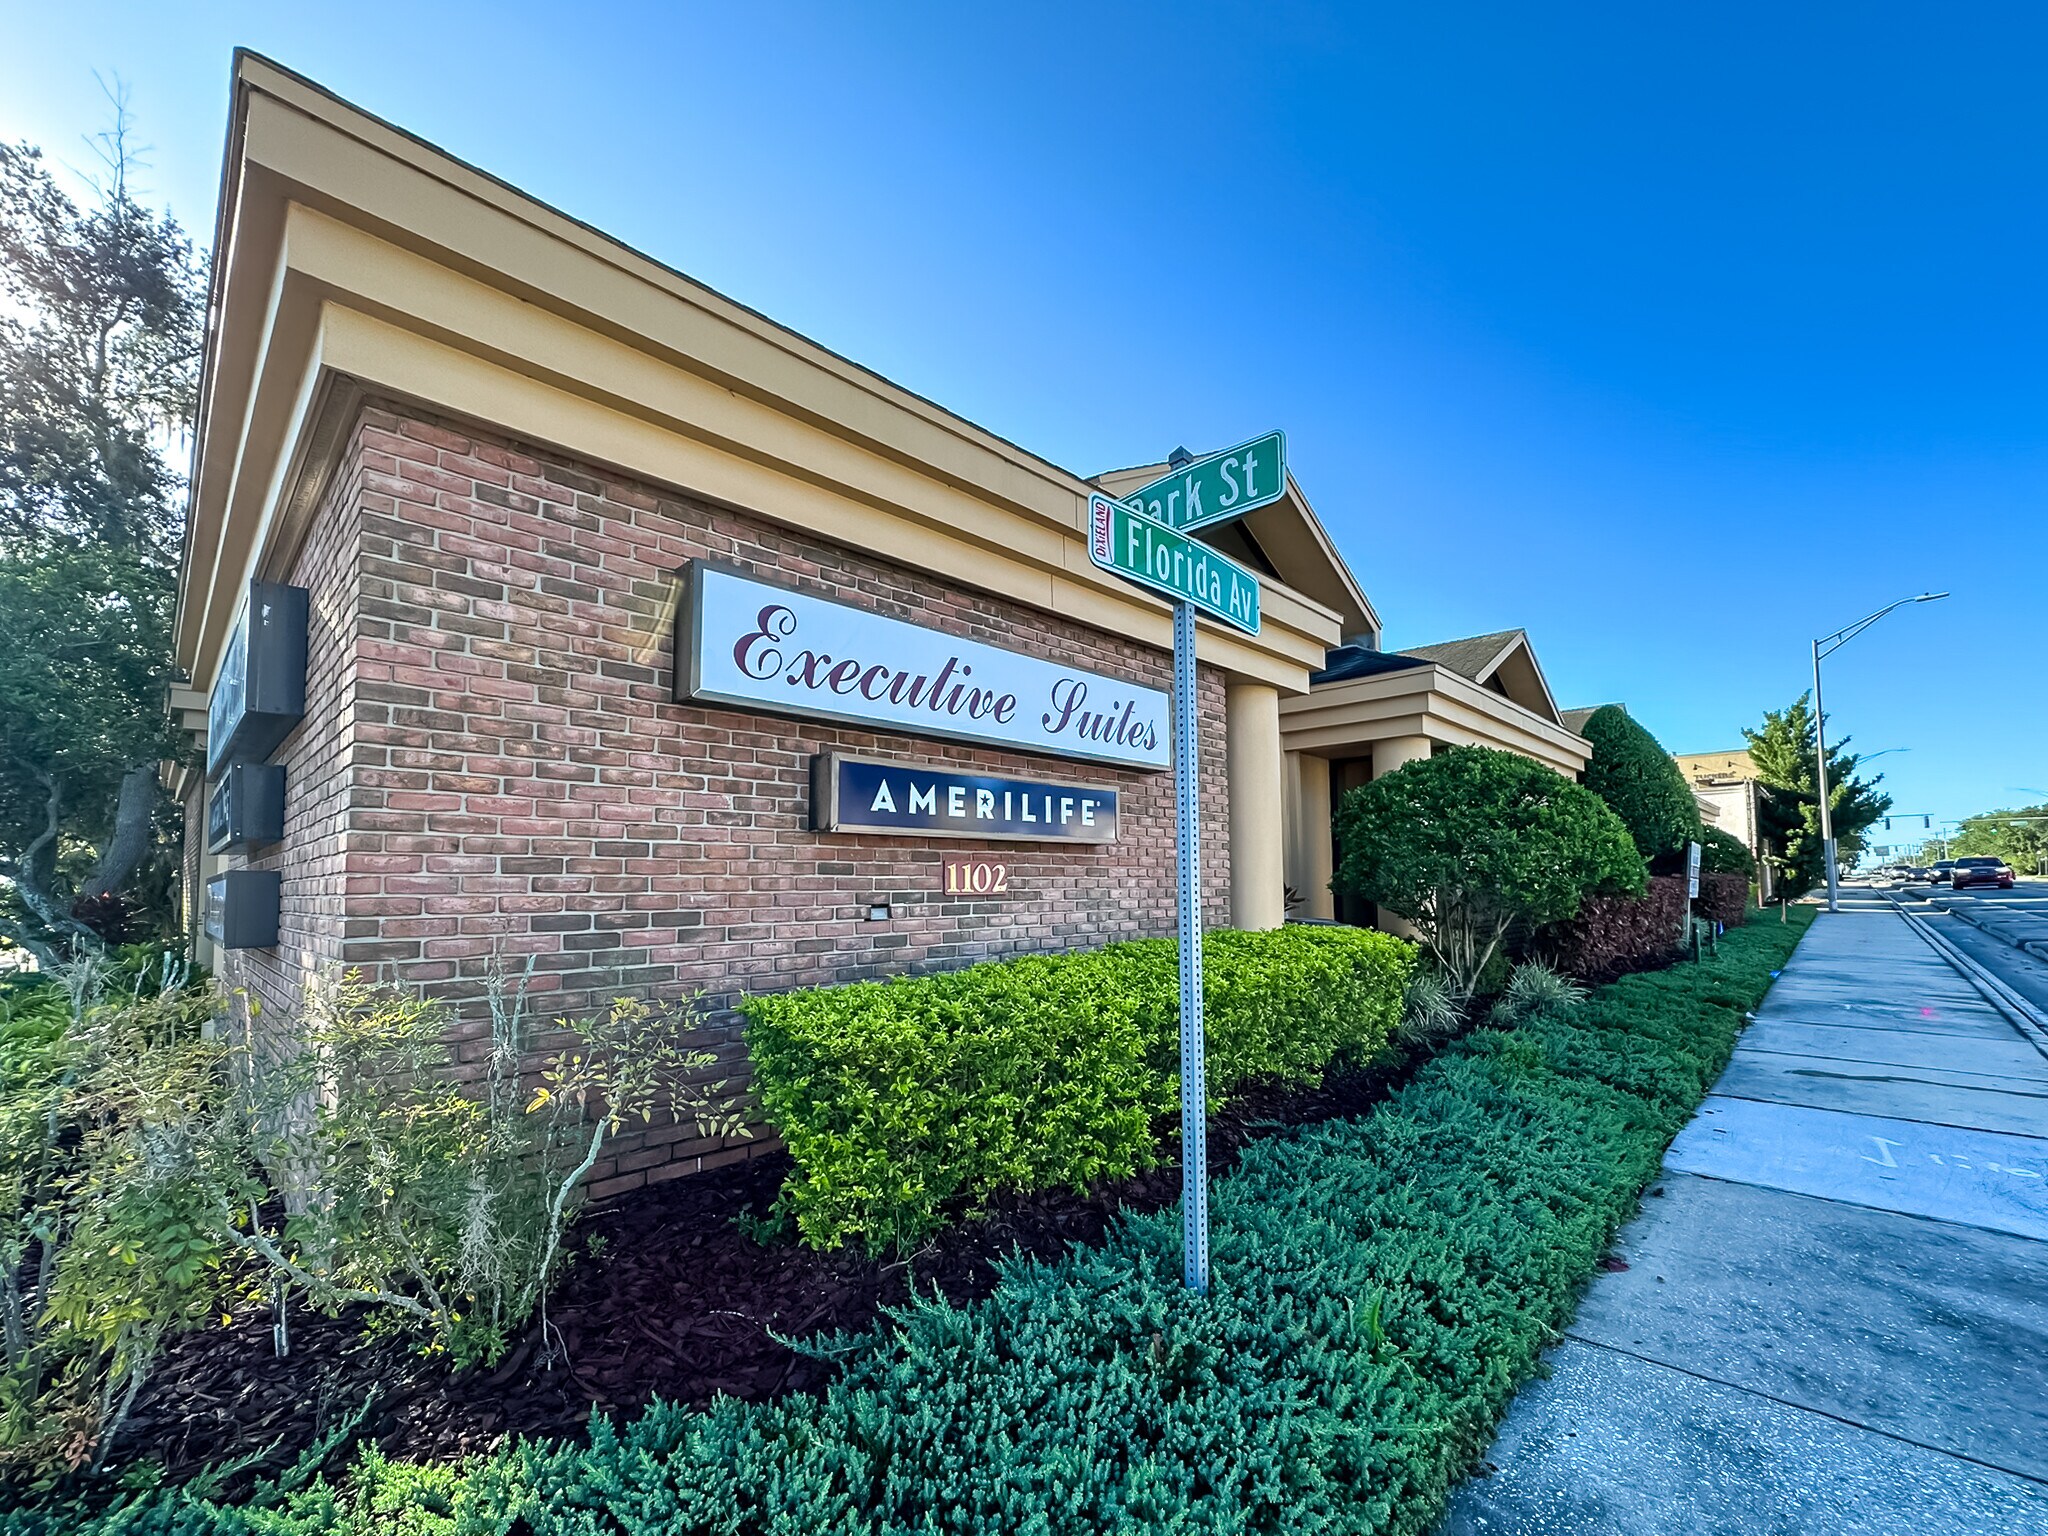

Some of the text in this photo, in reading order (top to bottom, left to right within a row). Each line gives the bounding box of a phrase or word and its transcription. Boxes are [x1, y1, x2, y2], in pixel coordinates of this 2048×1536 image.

[1219, 450, 1258, 507] St
[1128, 518, 1251, 622] Florida Av
[733, 604, 1158, 750] Executive Suites
[870, 779, 1096, 827] AMERILIFE
[947, 863, 1008, 893] 1102
